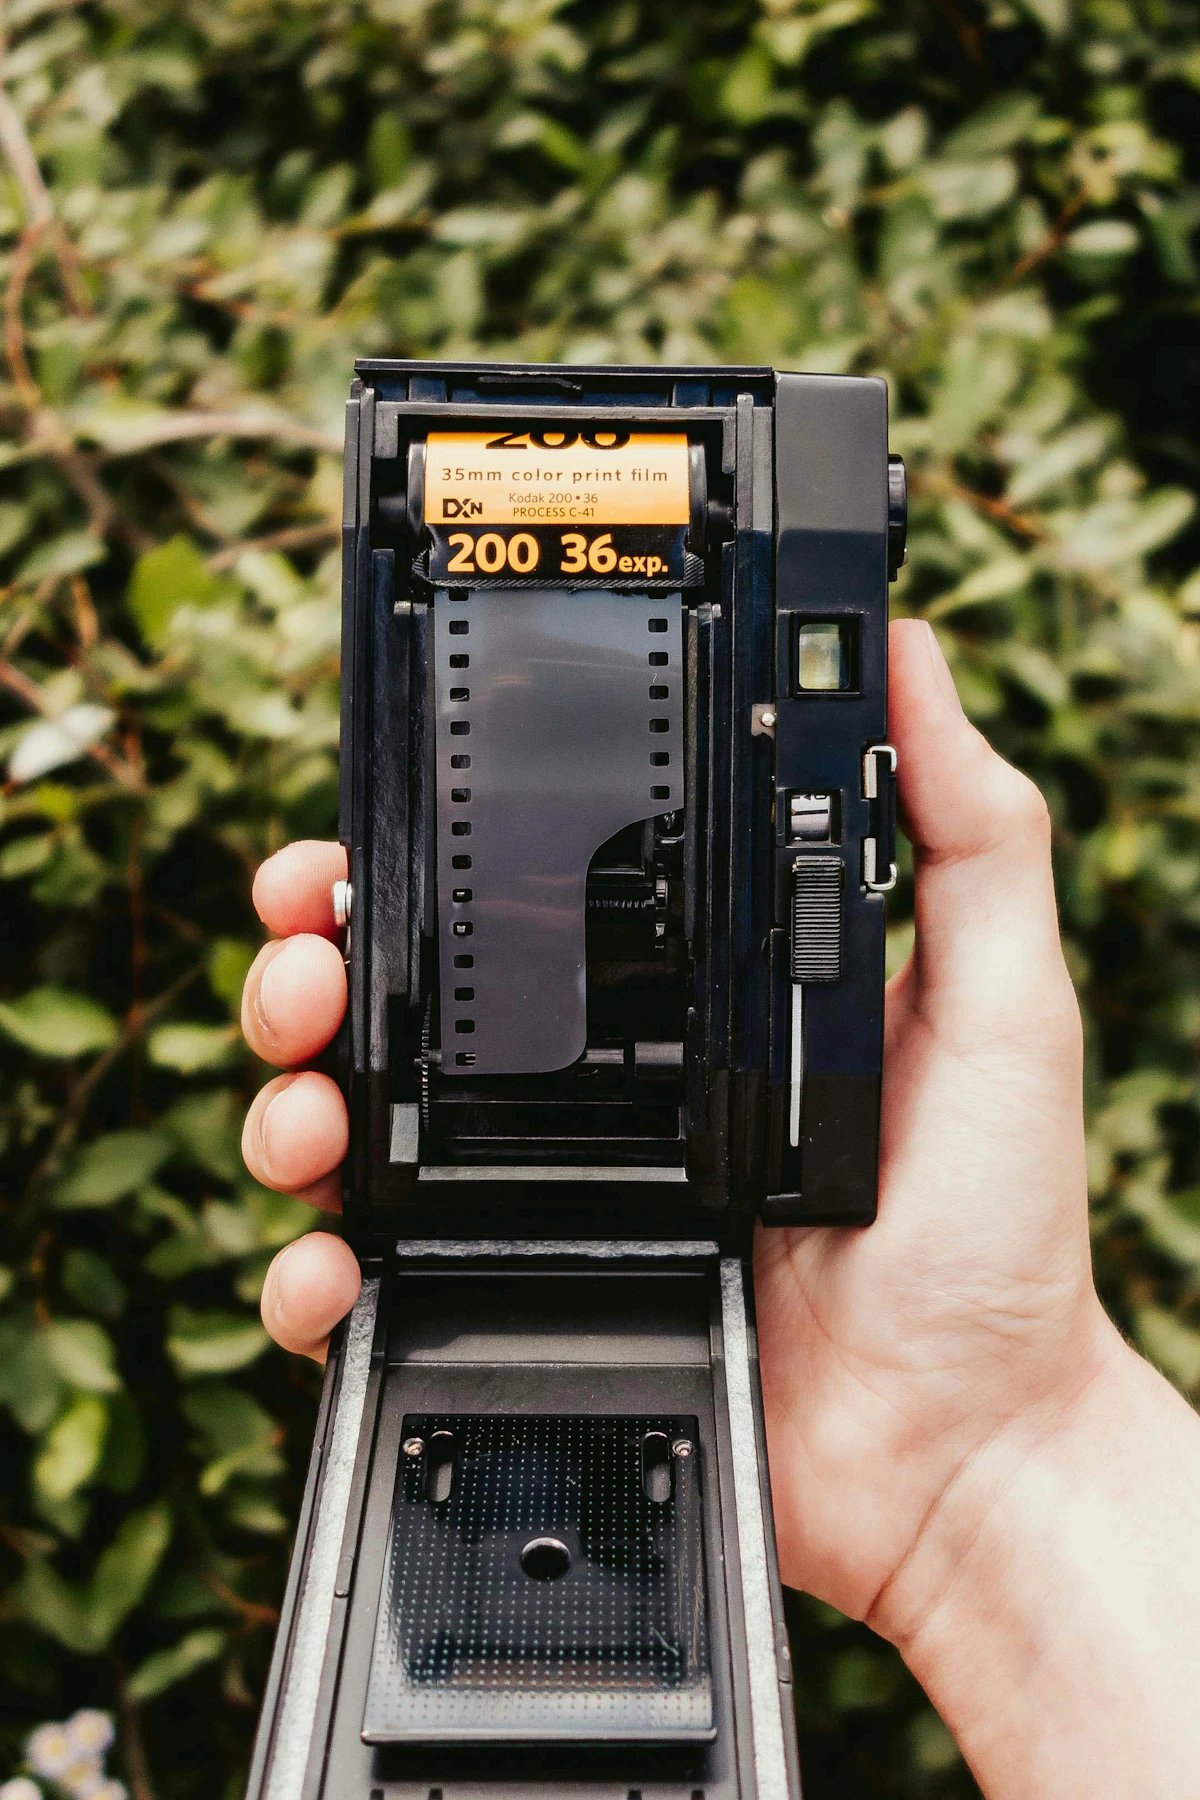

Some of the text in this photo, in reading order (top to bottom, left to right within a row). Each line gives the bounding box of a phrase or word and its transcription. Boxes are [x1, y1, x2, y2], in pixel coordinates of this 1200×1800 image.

[441, 467, 668, 485] 35mm color print film
[508, 492, 545, 504] Kodak
[512, 506, 595, 518] PROCESS C-41
[447, 532, 540, 573] 200
